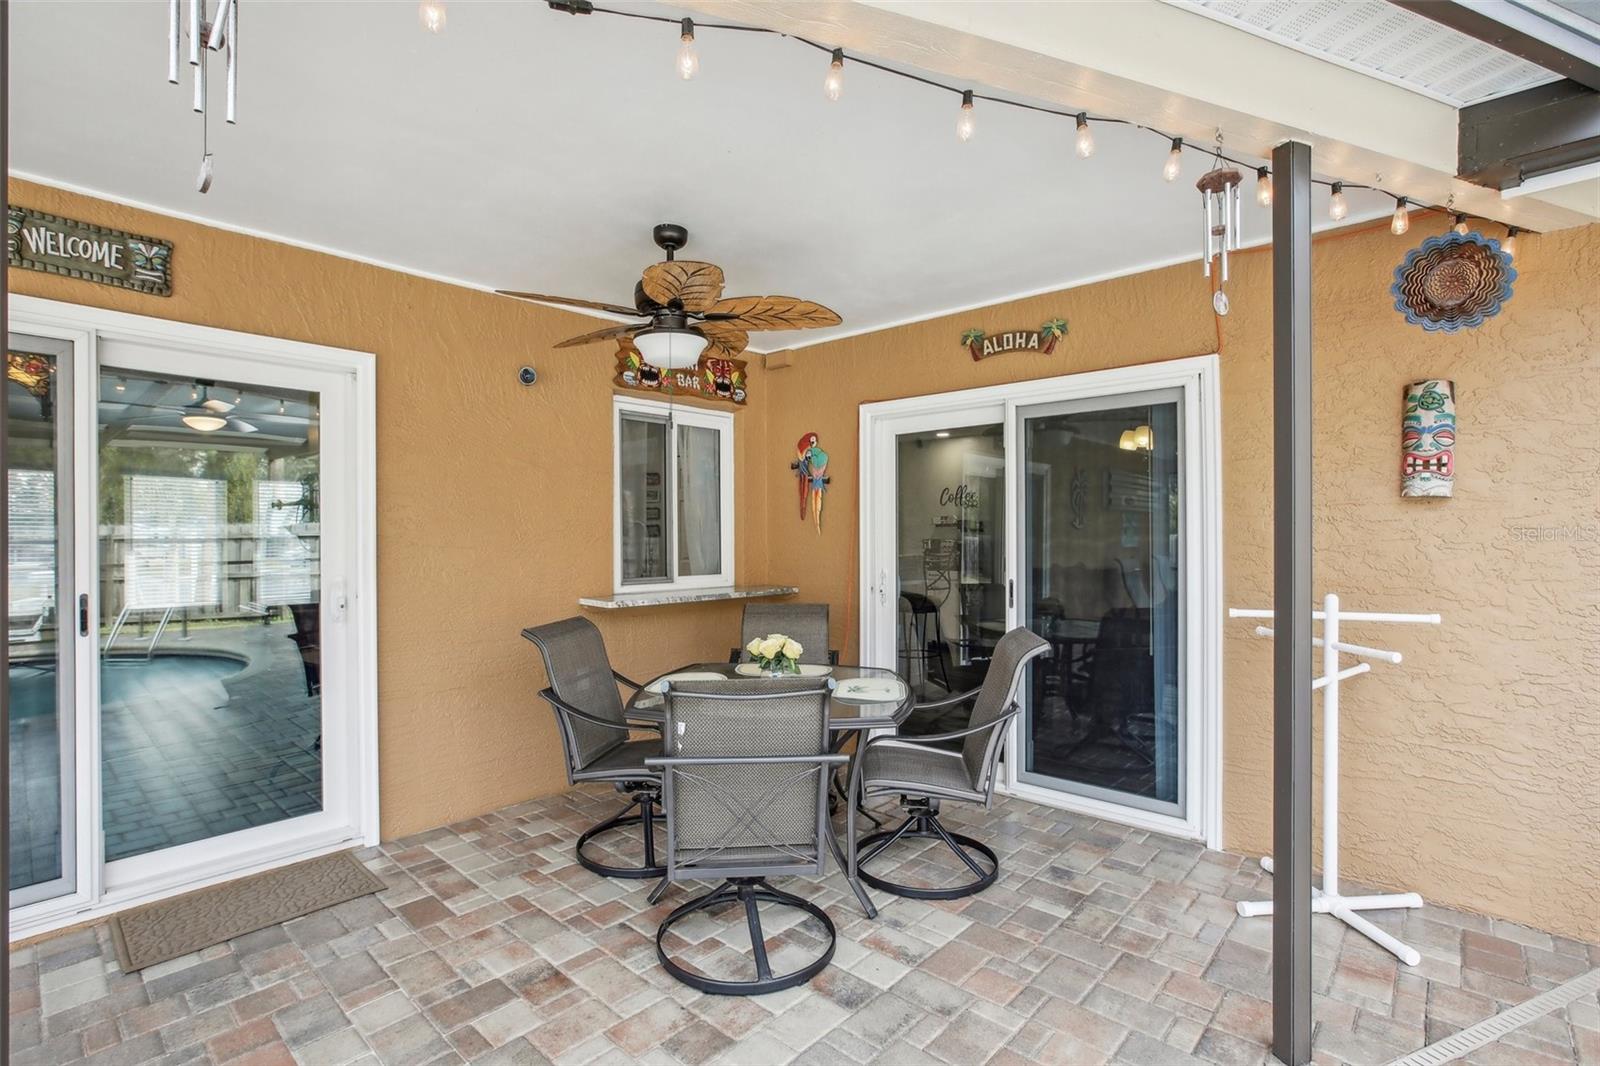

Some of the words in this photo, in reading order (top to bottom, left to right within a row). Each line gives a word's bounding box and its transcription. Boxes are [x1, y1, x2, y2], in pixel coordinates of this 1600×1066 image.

[22, 226, 124, 270] WELCOME
[983, 332, 1039, 355] ALOHA
[676, 373, 701, 390] BAR
[939, 484, 977, 507] Coffee
